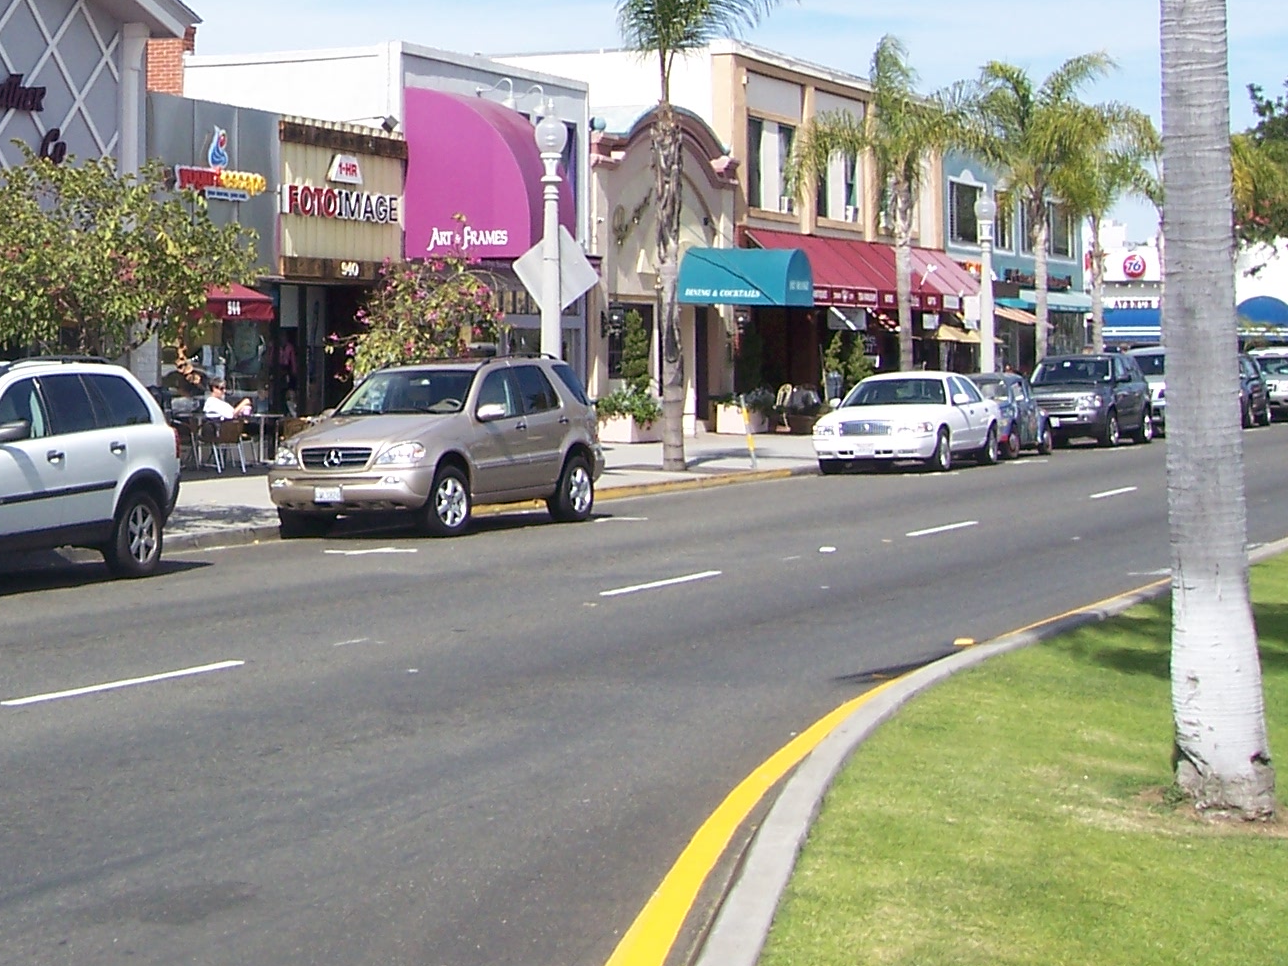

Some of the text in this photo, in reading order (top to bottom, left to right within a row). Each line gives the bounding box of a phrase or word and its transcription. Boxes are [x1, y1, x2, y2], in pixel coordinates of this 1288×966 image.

[339, 163, 357, 177] 1-HR
[286, 185, 399, 222] FOTOIMAGE
[341, 261, 360, 276] 940
[685, 288, 761, 298] DINING & COCKTAILS
